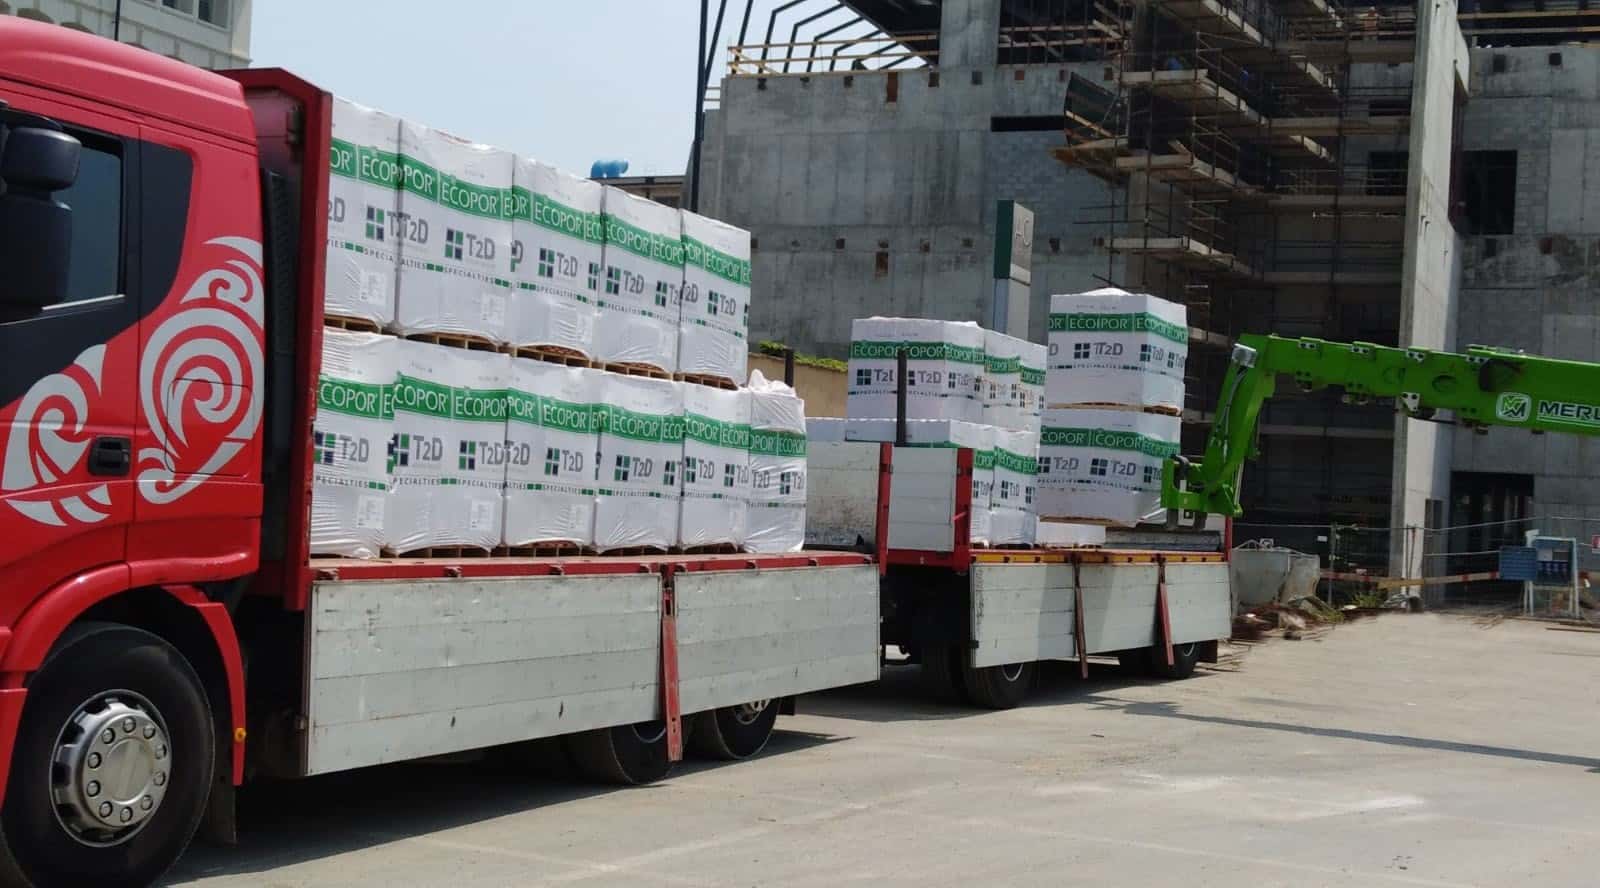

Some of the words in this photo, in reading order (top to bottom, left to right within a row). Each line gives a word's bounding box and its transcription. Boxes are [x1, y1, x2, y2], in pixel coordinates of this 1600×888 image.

[362, 155, 401, 182] ECOP
[403, 164, 433, 194] POR
[441, 182, 497, 214] ECOPOR
[535, 201, 583, 233] ECOPOR
[466, 233, 495, 260] T2D
[401, 259, 427, 270] ALTIES
[557, 252, 578, 277] T2D
[623, 270, 645, 294] T2D
[719, 294, 737, 316] T2D
[917, 370, 942, 384] T2D
[320, 383, 375, 413] COPOR
[395, 383, 447, 412] COPOR
[455, 396, 507, 417] ECOPOR
[508, 396, 533, 418] POR
[543, 405, 586, 430] ECOPOR
[1540, 401, 1600, 420] MERL
[613, 414, 658, 437] ECOPOR
[686, 418, 718, 440] COPOR
[1041, 431, 1084, 443] COPOR
[339, 435, 369, 463] T2D
[413, 435, 443, 461] T2D
[479, 441, 505, 464] T2D
[506, 440, 531, 465] T2D
[562, 450, 584, 473] T2D
[633, 457, 653, 477] T2D
[698, 459, 714, 479] T2D
[1053, 457, 1079, 470] T2D
[1111, 460, 1137, 476] T2D
[316, 476, 368, 488] PECIALTIES
[393, 478, 440, 486] PECIALTIES
